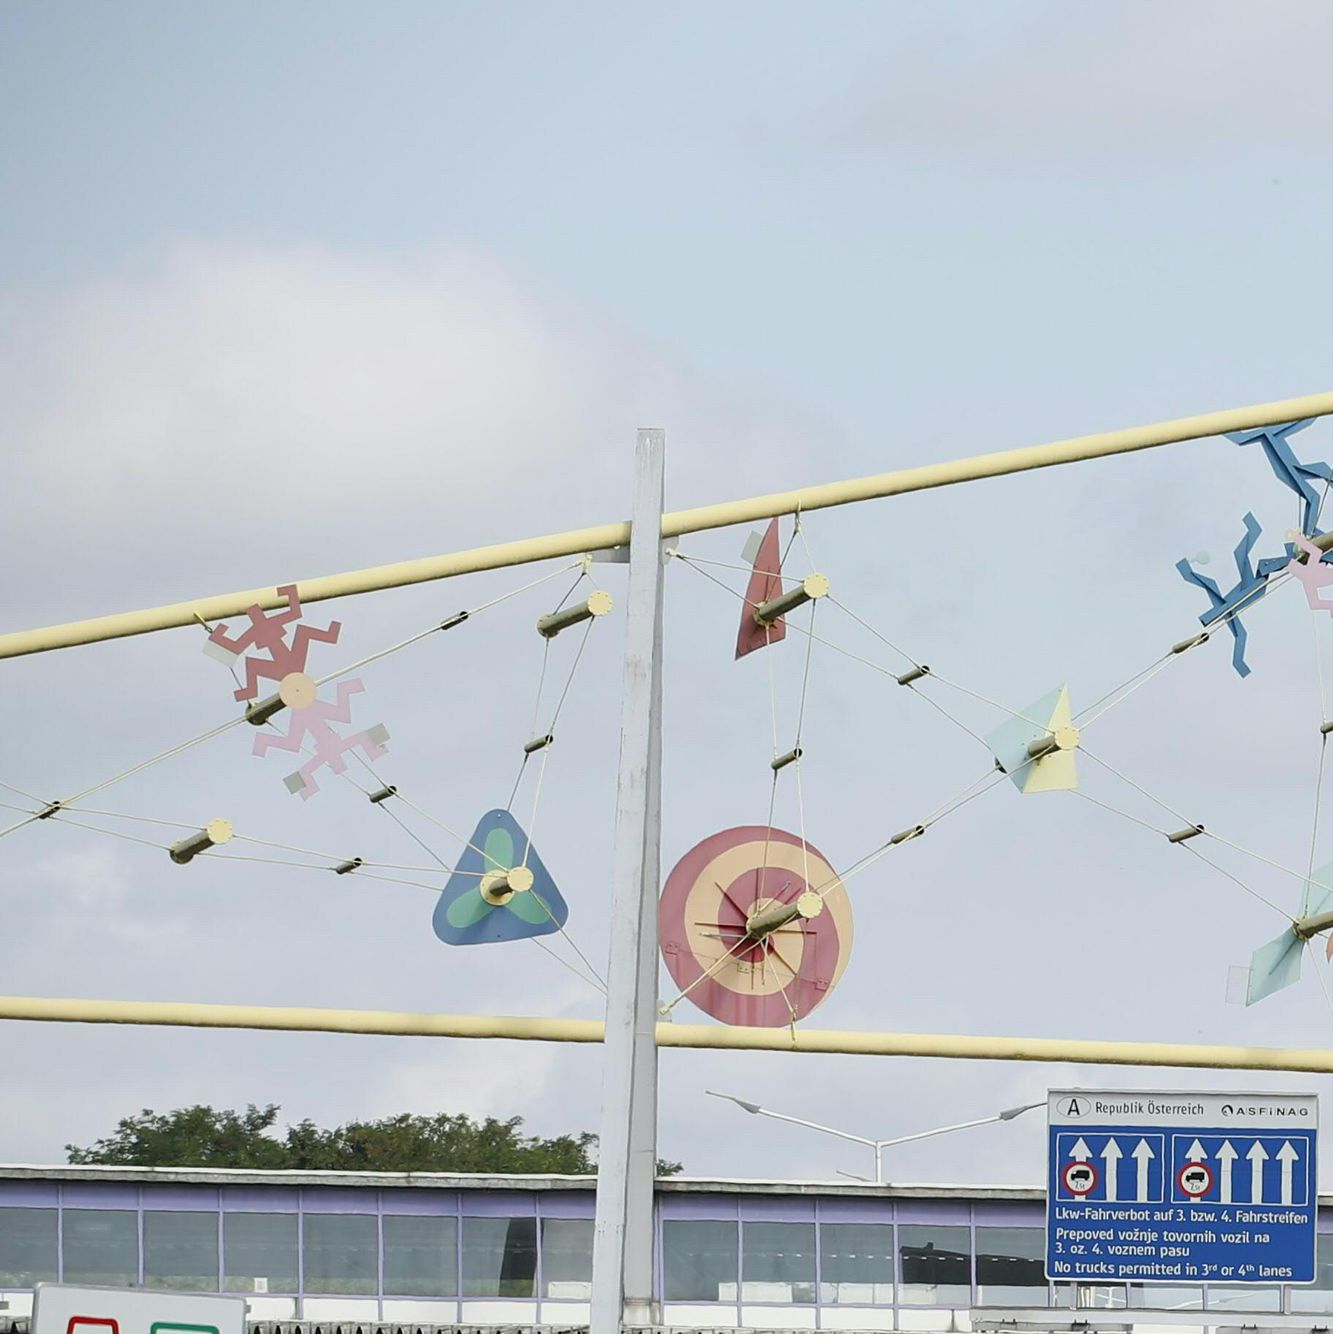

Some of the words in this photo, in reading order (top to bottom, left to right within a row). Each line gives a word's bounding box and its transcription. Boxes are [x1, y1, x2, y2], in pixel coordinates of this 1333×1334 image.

[1067, 1098, 1080, 1115] A
[1095, 1102, 1144, 1116] Republik
[1147, 1100, 1204, 1115] Österreich
[1055, 1207, 1150, 1222] Lkw-Fahrverbot
[1153, 1208, 1173, 1221] auf
[1176, 1210, 1187, 1222] 3.
[1190, 1209, 1217, 1223] bzw.
[1221, 1211, 1232, 1223] 4.
[1236, 1211, 1308, 1224] Fahrstreifen
[1056, 1228, 1114, 1243] Prepoved
[1118, 1227, 1158, 1244] vožnje
[1163, 1230, 1216, 1243] tovornih
[1221, 1231, 1250, 1243] vozil
[1254, 1233, 1270, 1243] na
[1055, 1243, 1066, 1254] 3.
[1070, 1246, 1088, 1255] oz.
[1091, 1244, 1103, 1255] 4.
[1108, 1245, 1155, 1256] voznem
[1160, 1247, 1190, 1258] pasu
[1054, 1261, 1071, 1273] No
[1075, 1262, 1114, 1274] trucks
[1119, 1262, 1181, 1277] permitted
[1186, 1263, 1197, 1275] in
[1221, 1266, 1235, 1276] or
[1259, 1264, 1292, 1277] lanes
